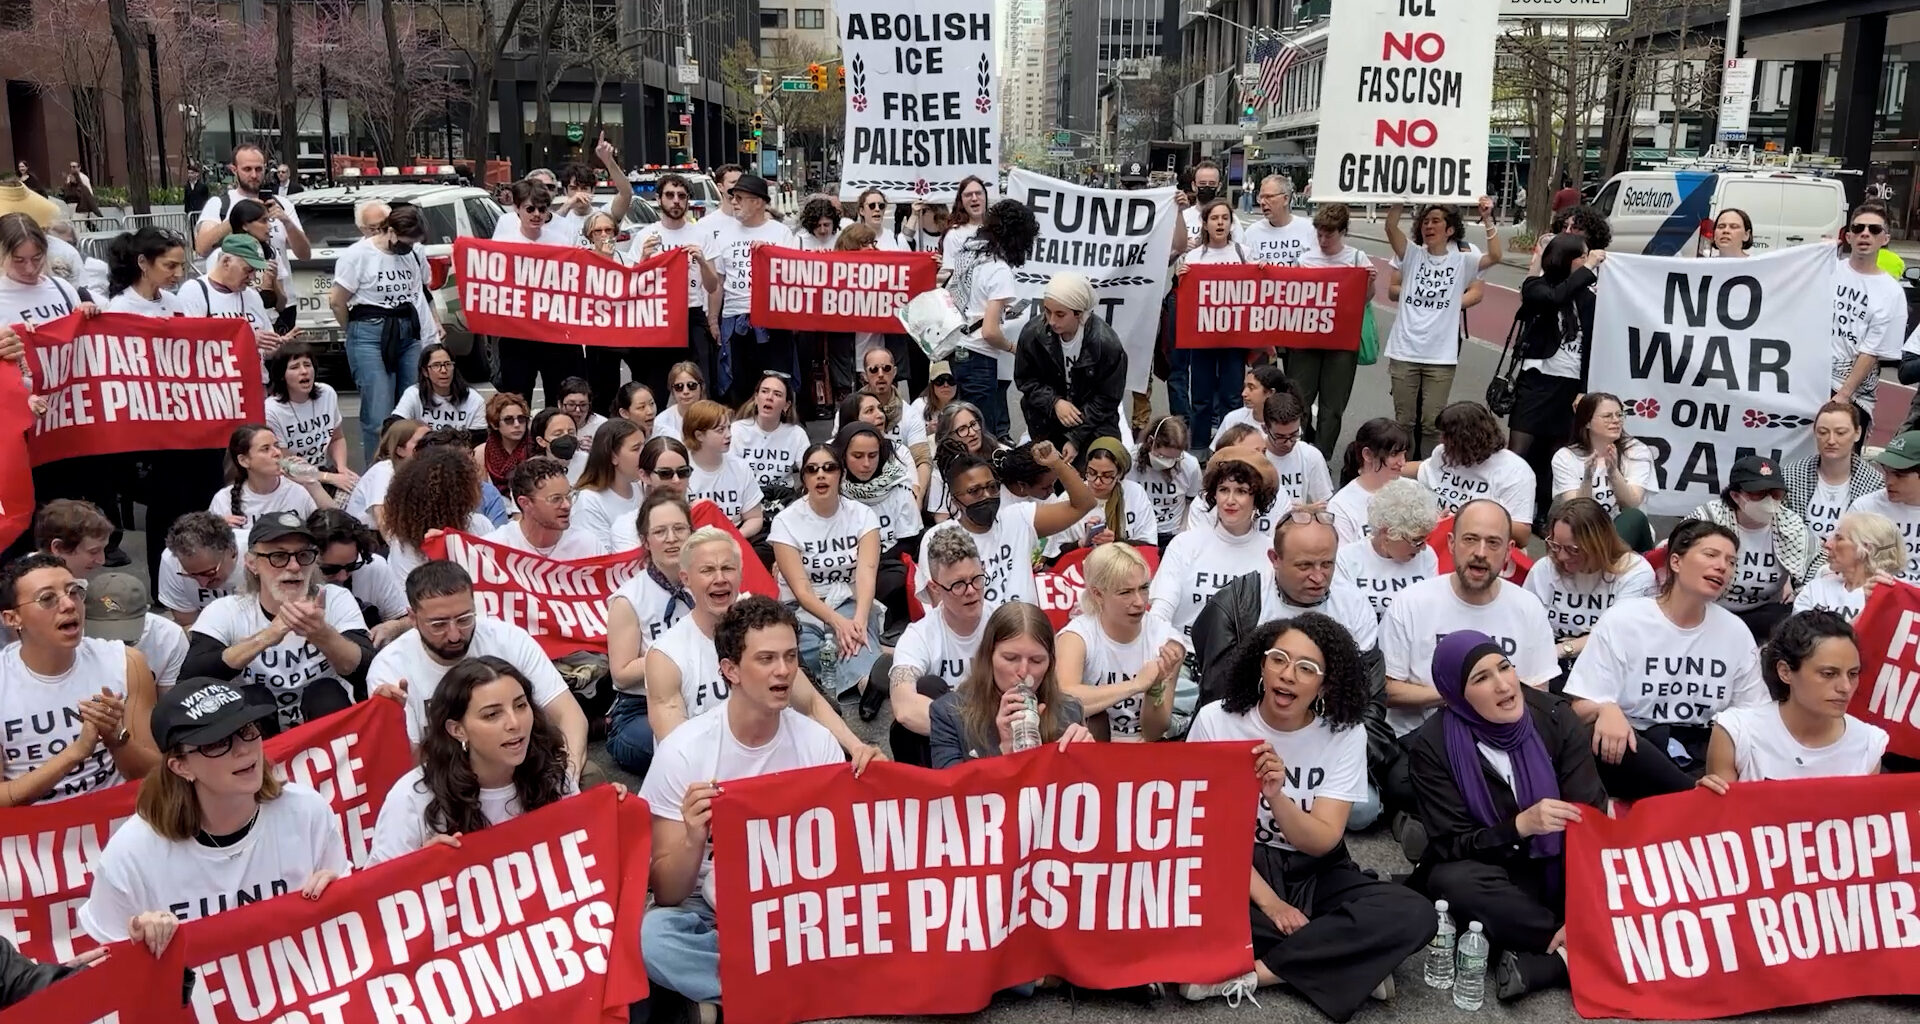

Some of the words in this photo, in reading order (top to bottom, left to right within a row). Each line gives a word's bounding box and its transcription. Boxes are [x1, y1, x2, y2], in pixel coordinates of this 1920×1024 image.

[847, 13, 990, 42] ABOLISH
[895, 46, 943, 75] ICE
[1382, 31, 1446, 63] NO
[1357, 66, 1462, 108] FASCISM
[883, 92, 961, 122] FREE
[852, 127, 992, 167] PALESTINE
[1375, 119, 1438, 148] NO
[1339, 153, 1471, 196] GENOCIDE
[1623, 186, 1673, 211] Spectrum
[1025, 188, 1156, 237] FUND
[1259, 251, 1302, 259] PEOPLE
[1260, 239, 1301, 249] FUND
[377, 270, 412, 282] FUND
[466, 249, 506, 283] NO
[514, 254, 580, 293] WAR
[585, 265, 624, 299] NO
[629, 267, 668, 297] ICE
[769, 258, 829, 287] FUND
[832, 262, 910, 291] PEOPLE
[1418, 262, 1455, 279] FUND
[376, 284, 412, 293] PEOPL
[769, 286, 819, 315] NOT
[822, 291, 909, 318] BOMBS
[1199, 280, 1257, 305] FUND
[1259, 280, 1339, 307] PEOPLE
[1415, 288, 1448, 299] NOT
[1663, 272, 1763, 331] NO
[1836, 285, 1869, 307] UND
[20, 302, 69, 321] FUN
[465, 283, 526, 318] FREE
[532, 292, 669, 328] PALESTINE
[1405, 296, 1451, 310] BOMBS
[1197, 306, 1246, 333] NOT
[1250, 306, 1336, 333] BOMBS
[72, 334, 151, 378] WAR
[152, 338, 190, 379] NO
[196, 340, 242, 378] ICE
[1627, 326, 1792, 394] WAR
[101, 381, 247, 422] PALESTINE
[422, 407, 467, 421] FUND
[286, 413, 330, 438] FUND
[1671, 399, 1730, 432] ON
[287, 428, 334, 450] PEOPLE
[743, 448, 790, 461] FUND
[749, 461, 791, 473] EOPLE
[1144, 482, 1177, 495] ND
[1434, 486, 1473, 501] PEOP
[1441, 472, 1489, 494] FUND
[1437, 498, 1459, 514] NO
[1810, 503, 1841, 519] UN
[803, 535, 858, 553] FUND
[802, 554, 857, 569] PEOPL
[1743, 551, 1775, 567] ND
[506, 552, 602, 597] WAR
[474, 590, 548, 636] REE
[1547, 610, 1598, 627] PEOP
[261, 640, 320, 668] UND
[1646, 656, 1727, 678] FUND
[243, 660, 331, 687] PEOPLE
[1642, 682, 1725, 699] PEOPLE
[5, 706, 84, 742] FUN
[1652, 702, 1711, 720] NOT
[272, 732, 367, 810] CE
[1283, 766, 1325, 790] ND
[746, 807, 838, 893] NO
[853, 792, 1005, 874] WAR
[1018, 782, 1100, 860] NO
[1116, 780, 1209, 853] ICE
[0, 820, 112, 902] WA
[1601, 830, 1750, 910] FUND
[1750, 811, 1920, 890] PEOPL
[191, 911, 373, 1024] FUND
[378, 829, 605, 965] PEOPLE
[751, 882, 893, 976] FREE
[907, 857, 1202, 954] PALESTINE
[1611, 902, 1739, 984] NOT
[1747, 880, 1920, 967] BOMB
[366, 901, 615, 1024] BOMBS
